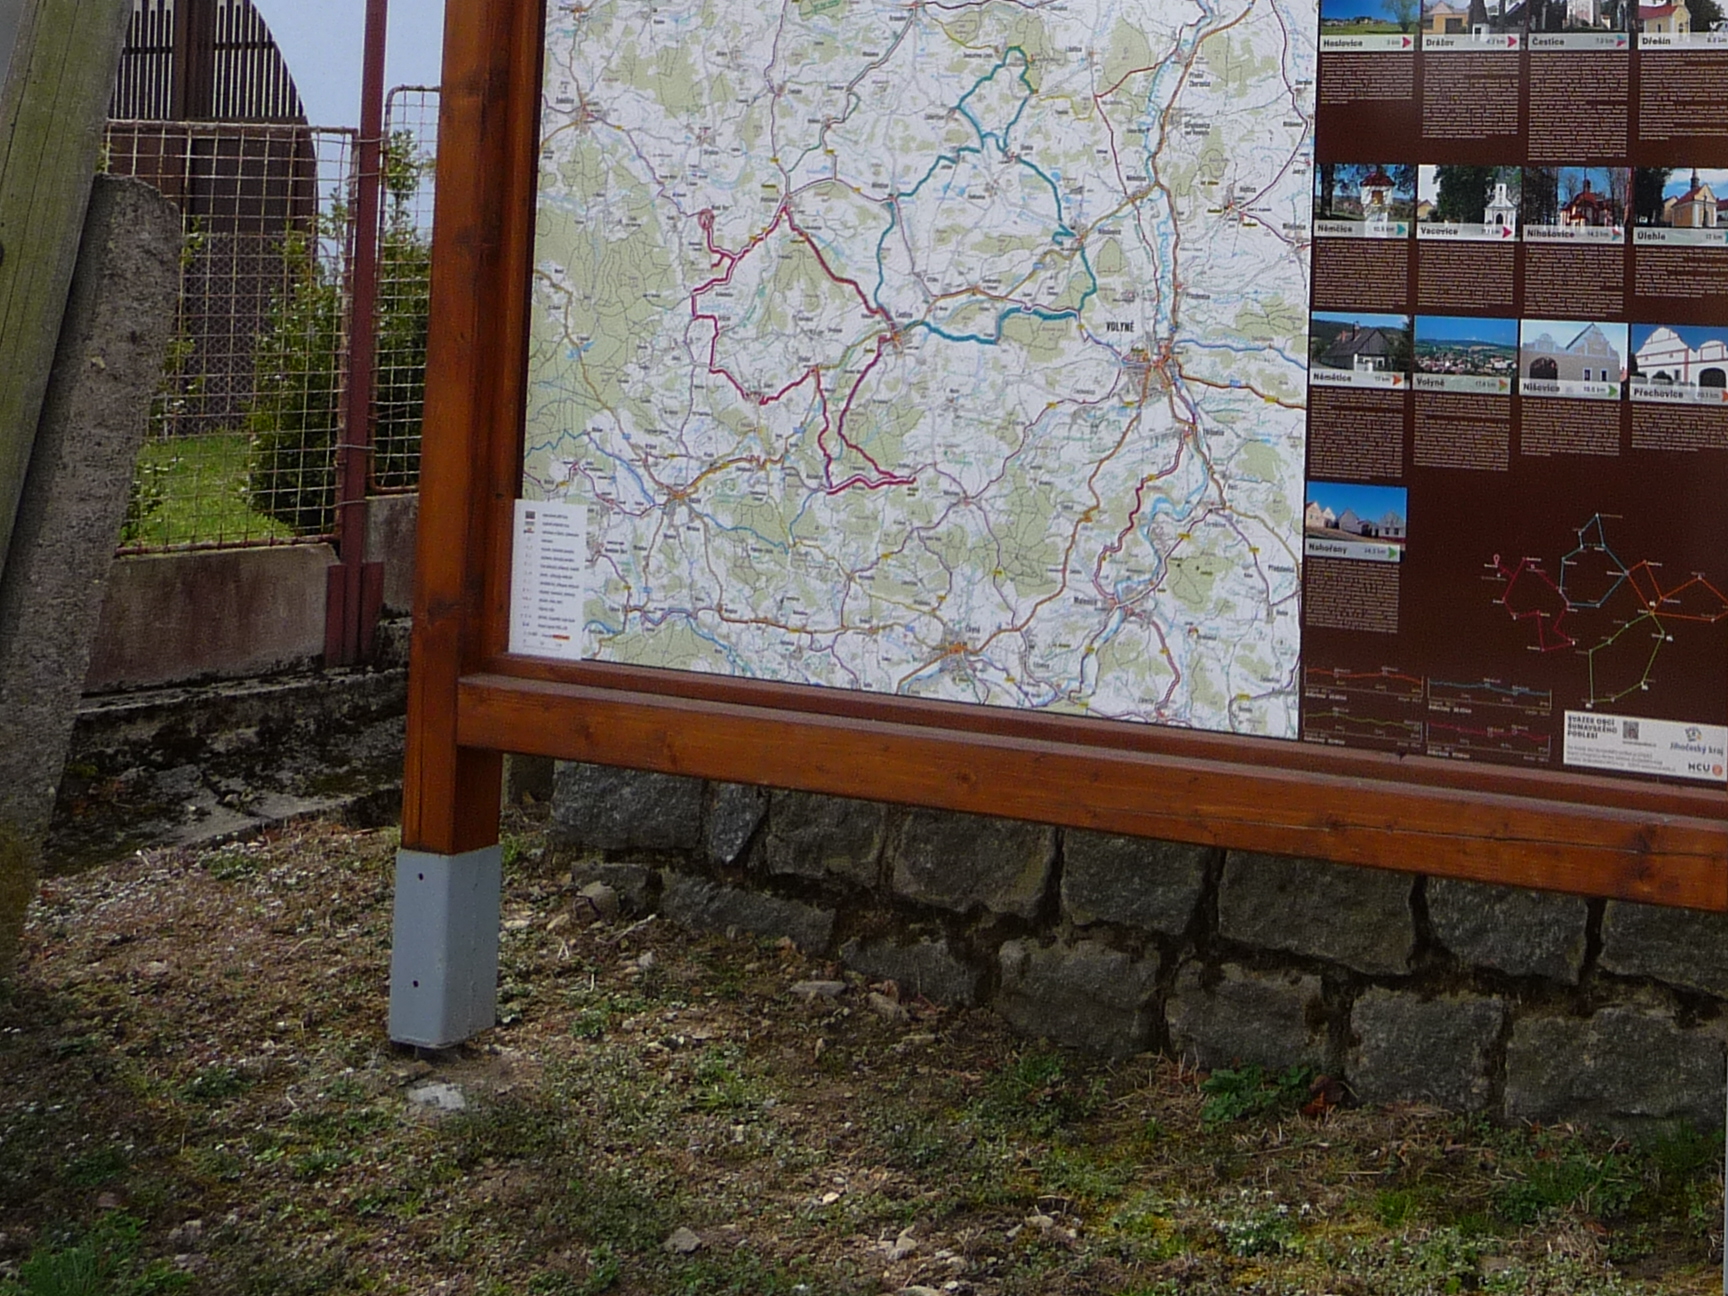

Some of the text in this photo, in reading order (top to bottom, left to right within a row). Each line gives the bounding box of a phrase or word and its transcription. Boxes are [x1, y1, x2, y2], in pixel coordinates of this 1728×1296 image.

[1323, 38, 1363, 48] Hoslovice
[1425, 37, 1455, 47] Drážov
[1532, 36, 1565, 46] Čestice
[1317, 223, 1353, 233] Němčice
[1420, 227, 1459, 236] Vacovice
[1526, 228, 1575, 238] Nihošovice
[1416, 377, 1446, 389] Volyně
[1523, 382, 1561, 392] Nišovice
[1633, 387, 1684, 399] Přechovice
